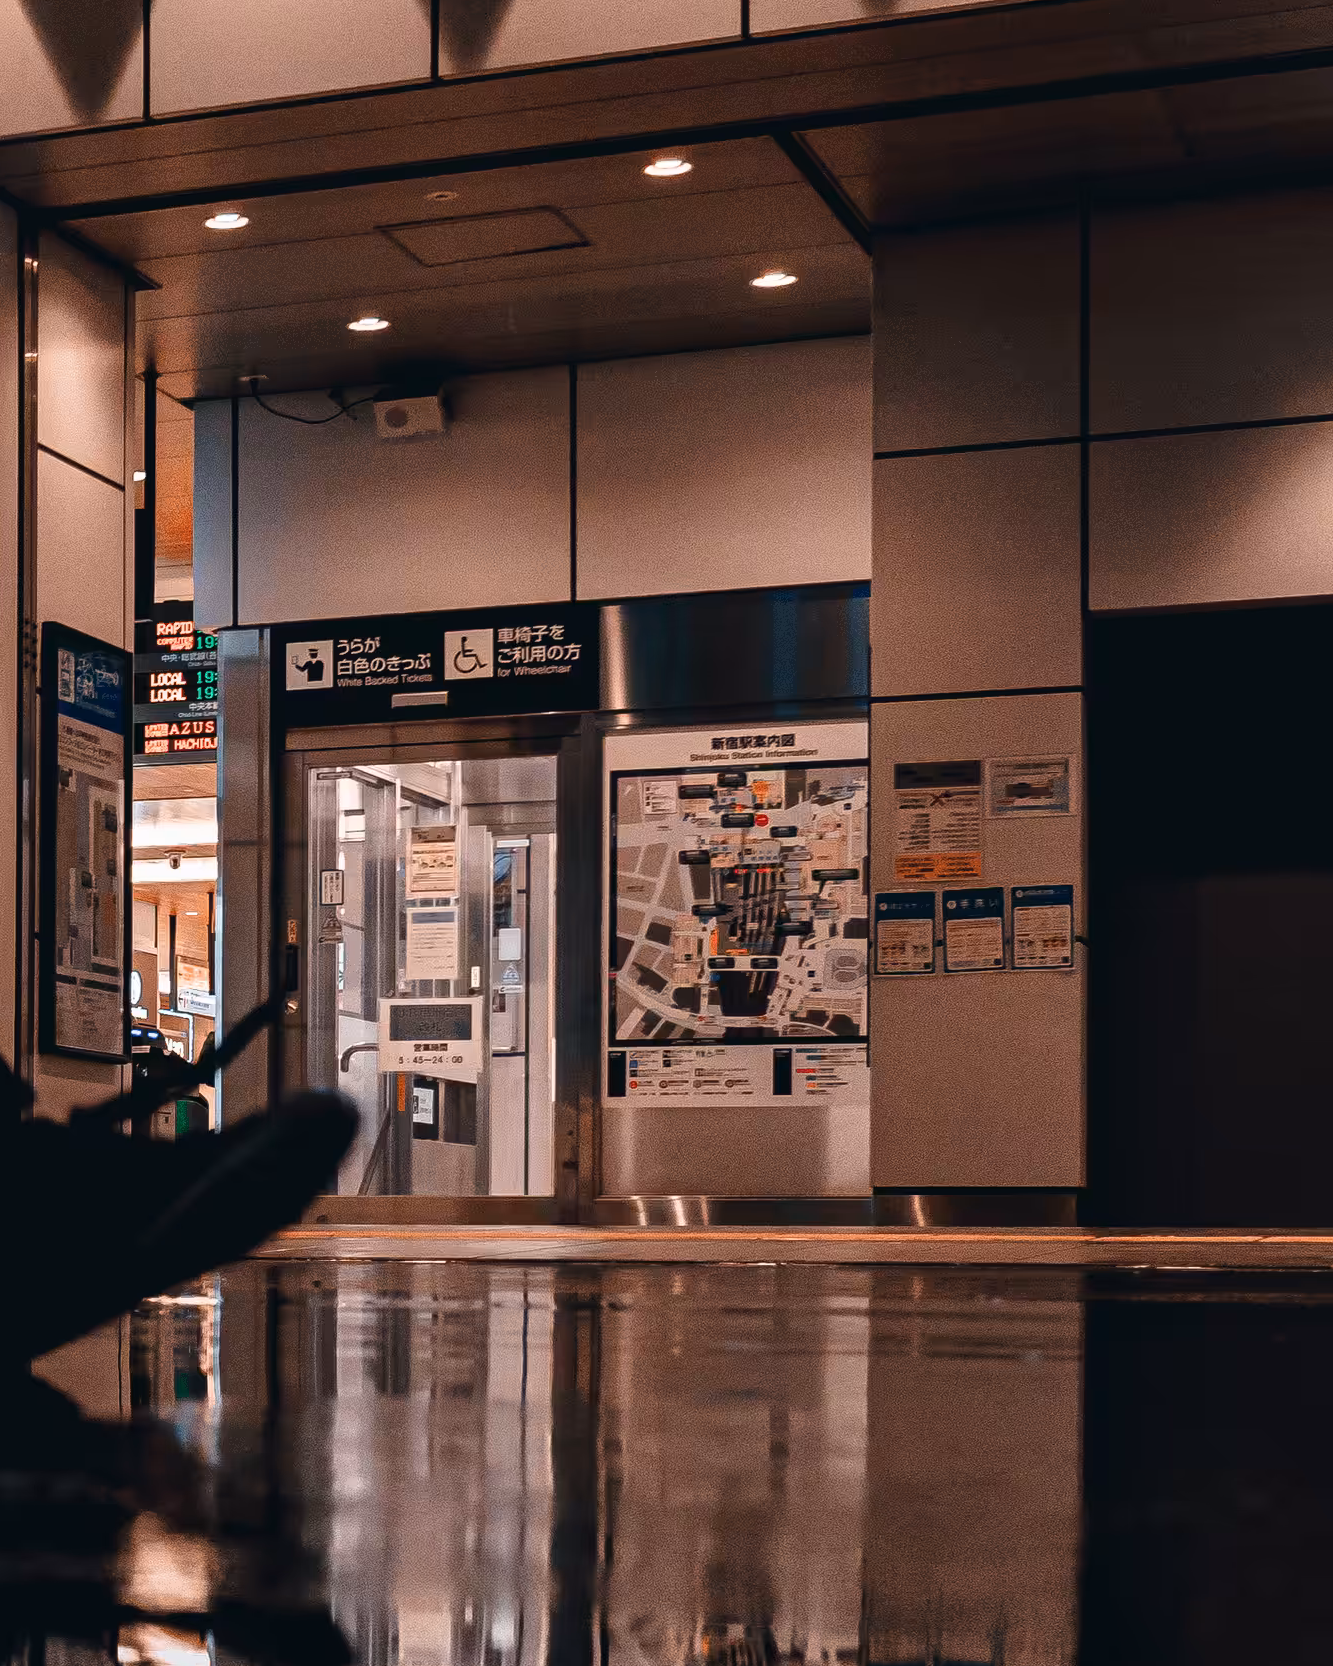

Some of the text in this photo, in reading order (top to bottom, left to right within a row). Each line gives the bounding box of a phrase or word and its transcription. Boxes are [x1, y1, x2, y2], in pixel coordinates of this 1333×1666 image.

[157, 621, 194, 635] RAPID
[498, 624, 565, 644] 車椅子を
[337, 637, 380, 655] うらが
[497, 643, 581, 665] ご利用の方
[337, 653, 432, 676] 白色のきっぷ
[514, 663, 571, 676] Wheelchair
[150, 672, 186, 687] LOCAL
[337, 672, 432, 688] White Backed Tickets
[150, 688, 186, 703] LOCAL
[169, 721, 215, 736] AZUS
[711, 734, 795, 750] 新宿駅案内図
[690, 748, 818, 762] Shinjuku Station Information
